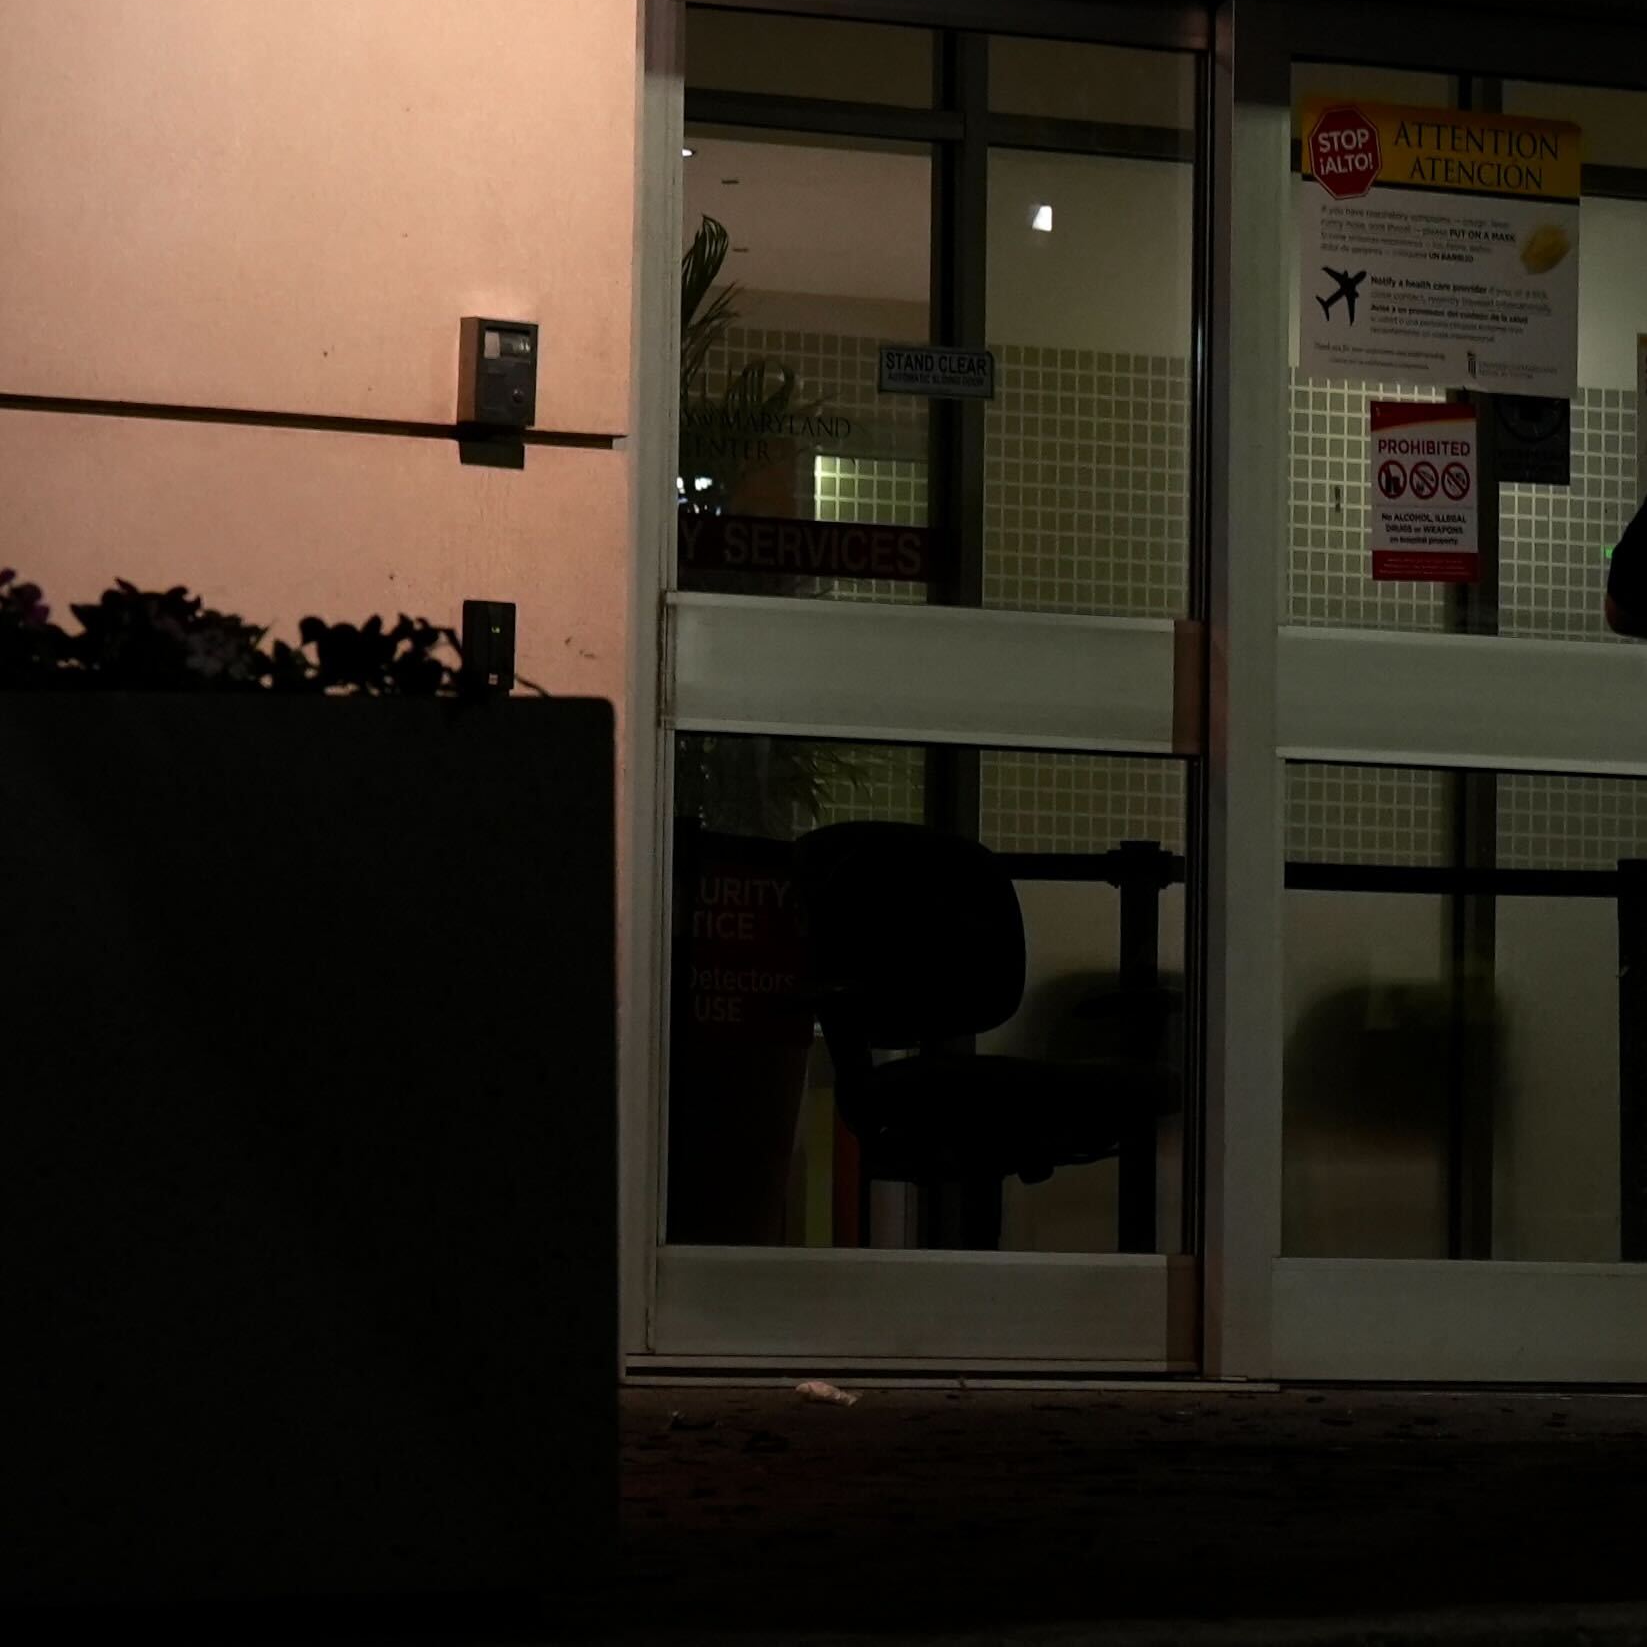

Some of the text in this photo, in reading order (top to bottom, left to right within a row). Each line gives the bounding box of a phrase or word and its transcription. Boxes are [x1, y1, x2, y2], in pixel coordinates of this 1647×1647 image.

[1317, 128, 1370, 153] STOP
[1393, 120, 1561, 161] ATTENTION
[1319, 154, 1374, 176] ¡ALTO!
[1408, 157, 1543, 191] ATENCIÓN
[1449, 228, 1466, 238] PUT
[1468, 230, 1482, 239] ON
[1483, 231, 1491, 240] A
[1370, 275, 1396, 288] Notify
[1405, 279, 1432, 289] health
[885, 352, 987, 376] STAND CLEAR
[1377, 439, 1471, 457] PROHIBITED
[1381, 512, 1392, 521] No
[1423, 525, 1464, 534] WEAPONS
[723, 521, 923, 576] SERVICES
[698, 875, 793, 910] URITY
[690, 961, 797, 994] etectors
[694, 993, 744, 1025] USE
